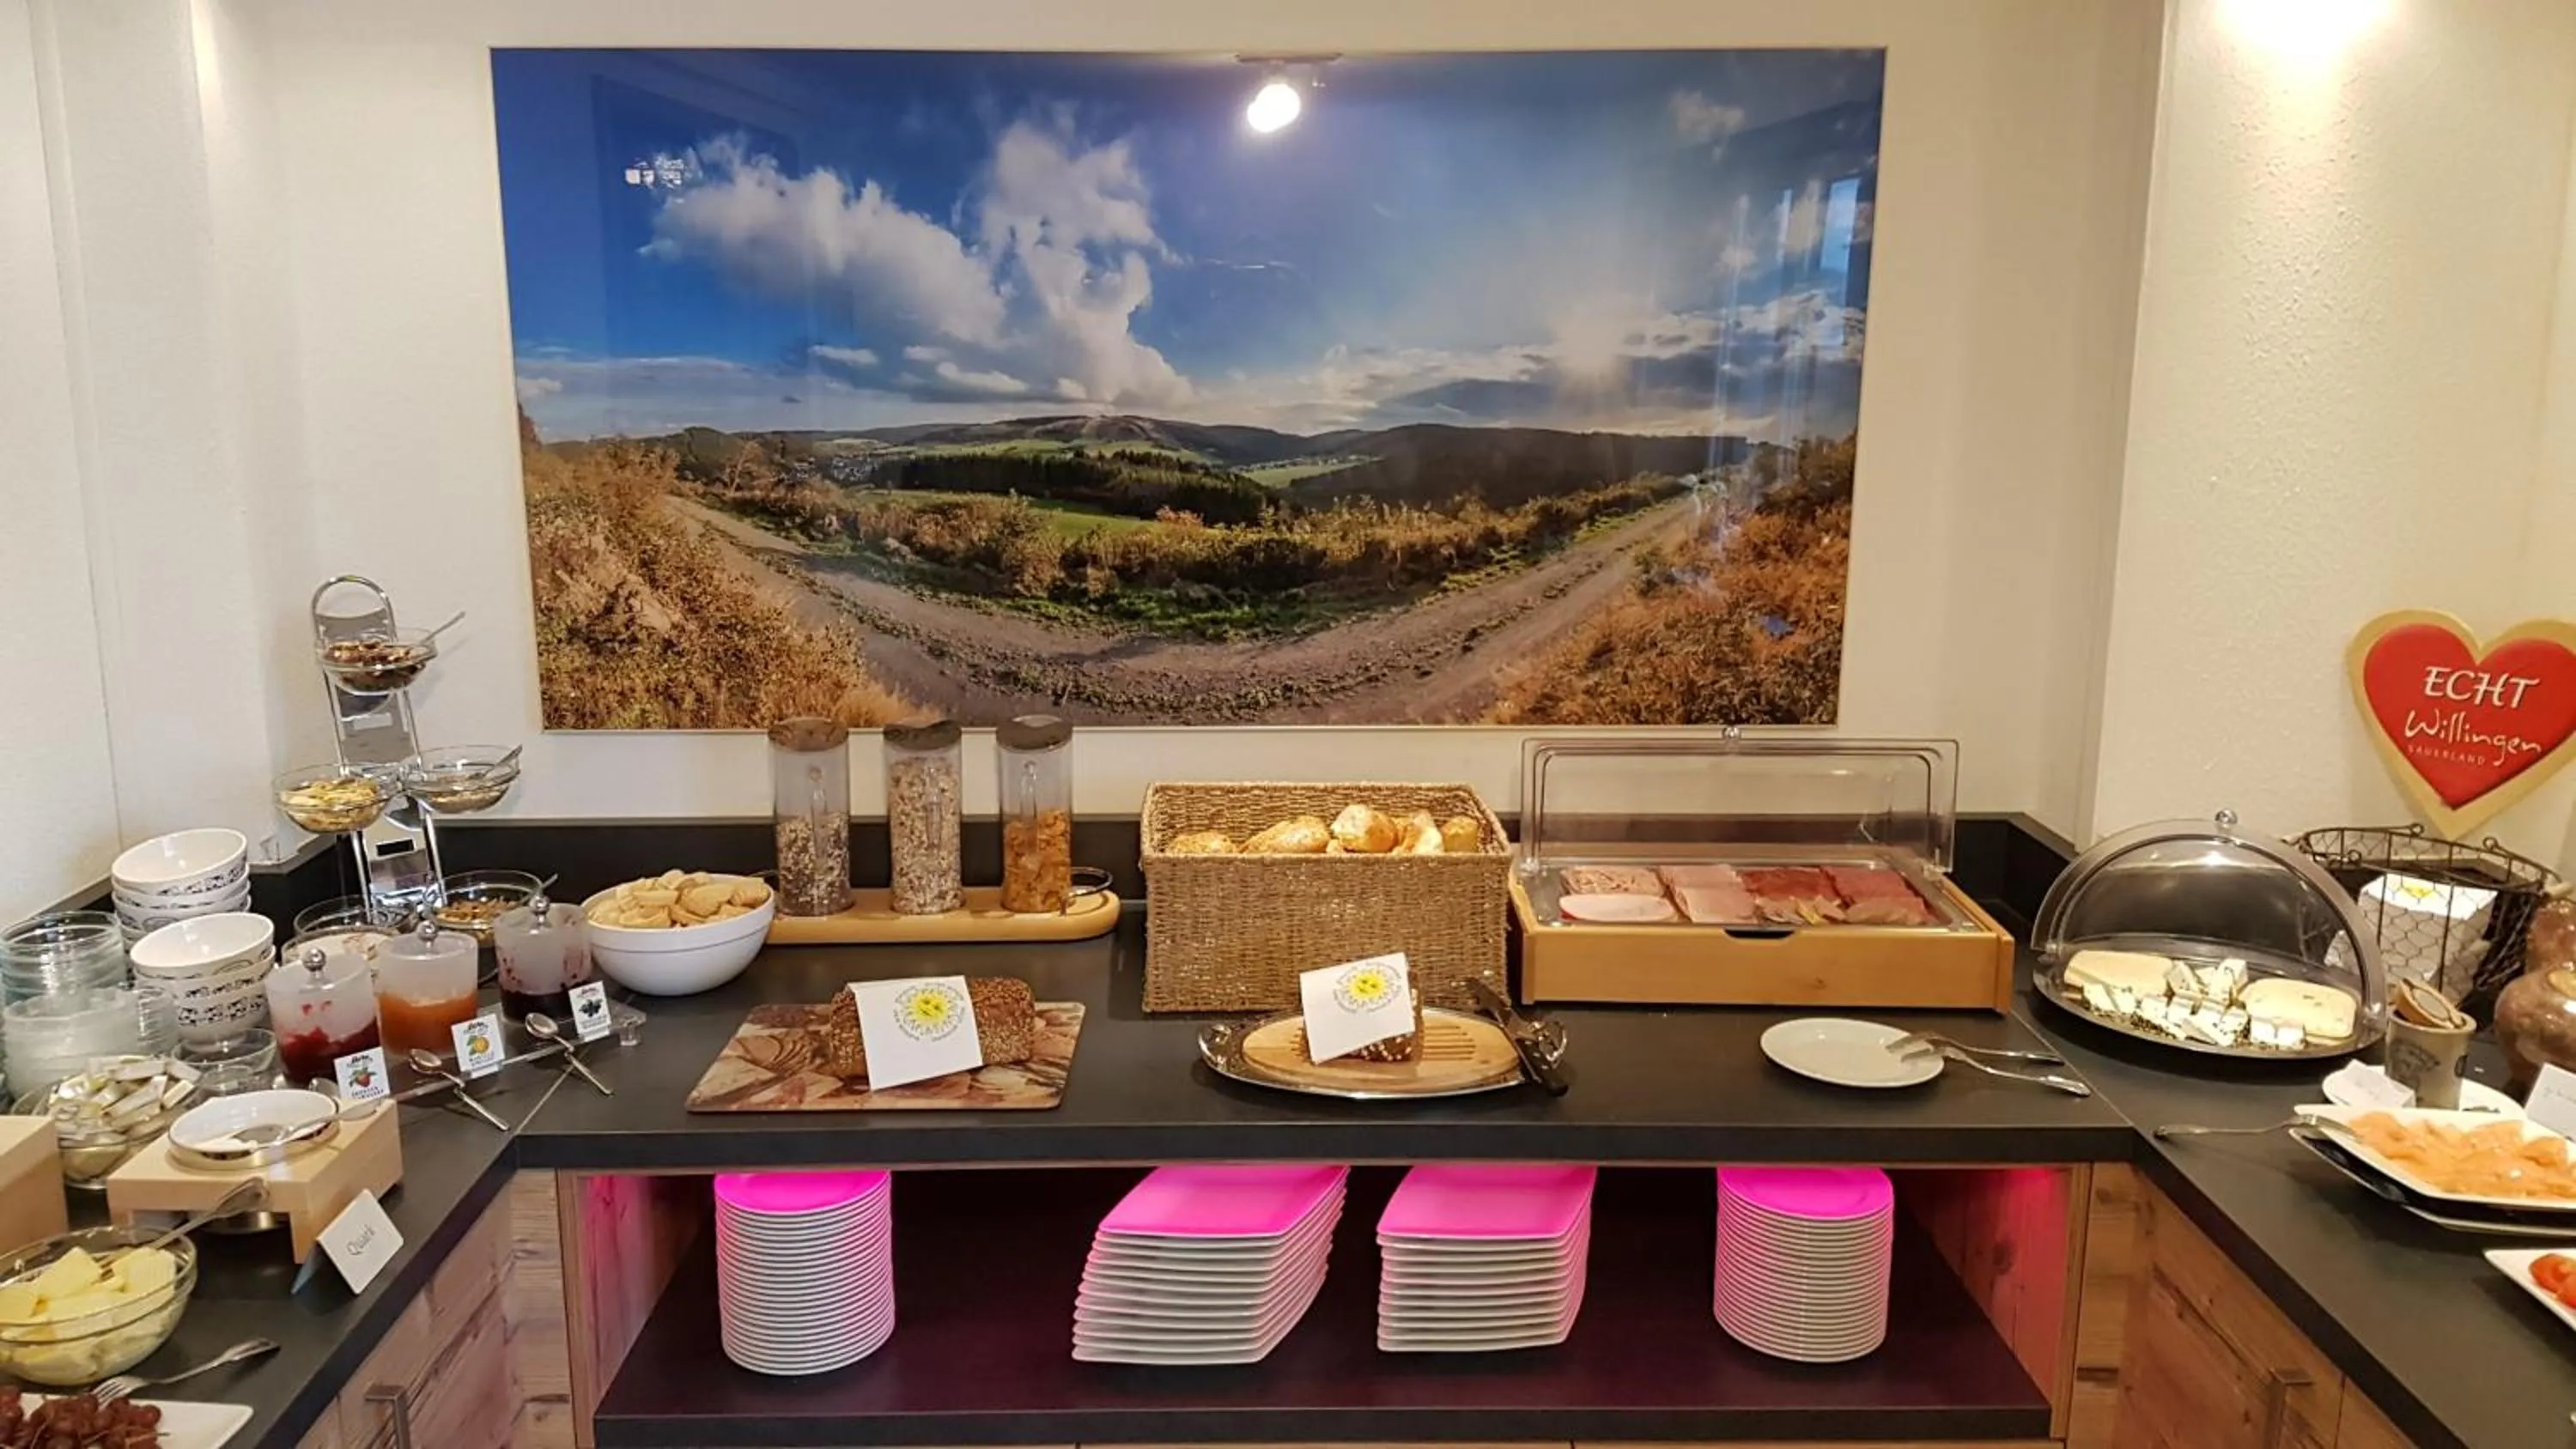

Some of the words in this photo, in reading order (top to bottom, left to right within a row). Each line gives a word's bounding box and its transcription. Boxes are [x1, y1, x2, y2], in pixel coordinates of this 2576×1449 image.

[2424, 665, 2540, 708] ECHT
[2404, 708, 2543, 767] Willingen
[2407, 744, 2486, 765] SAUERLAND
